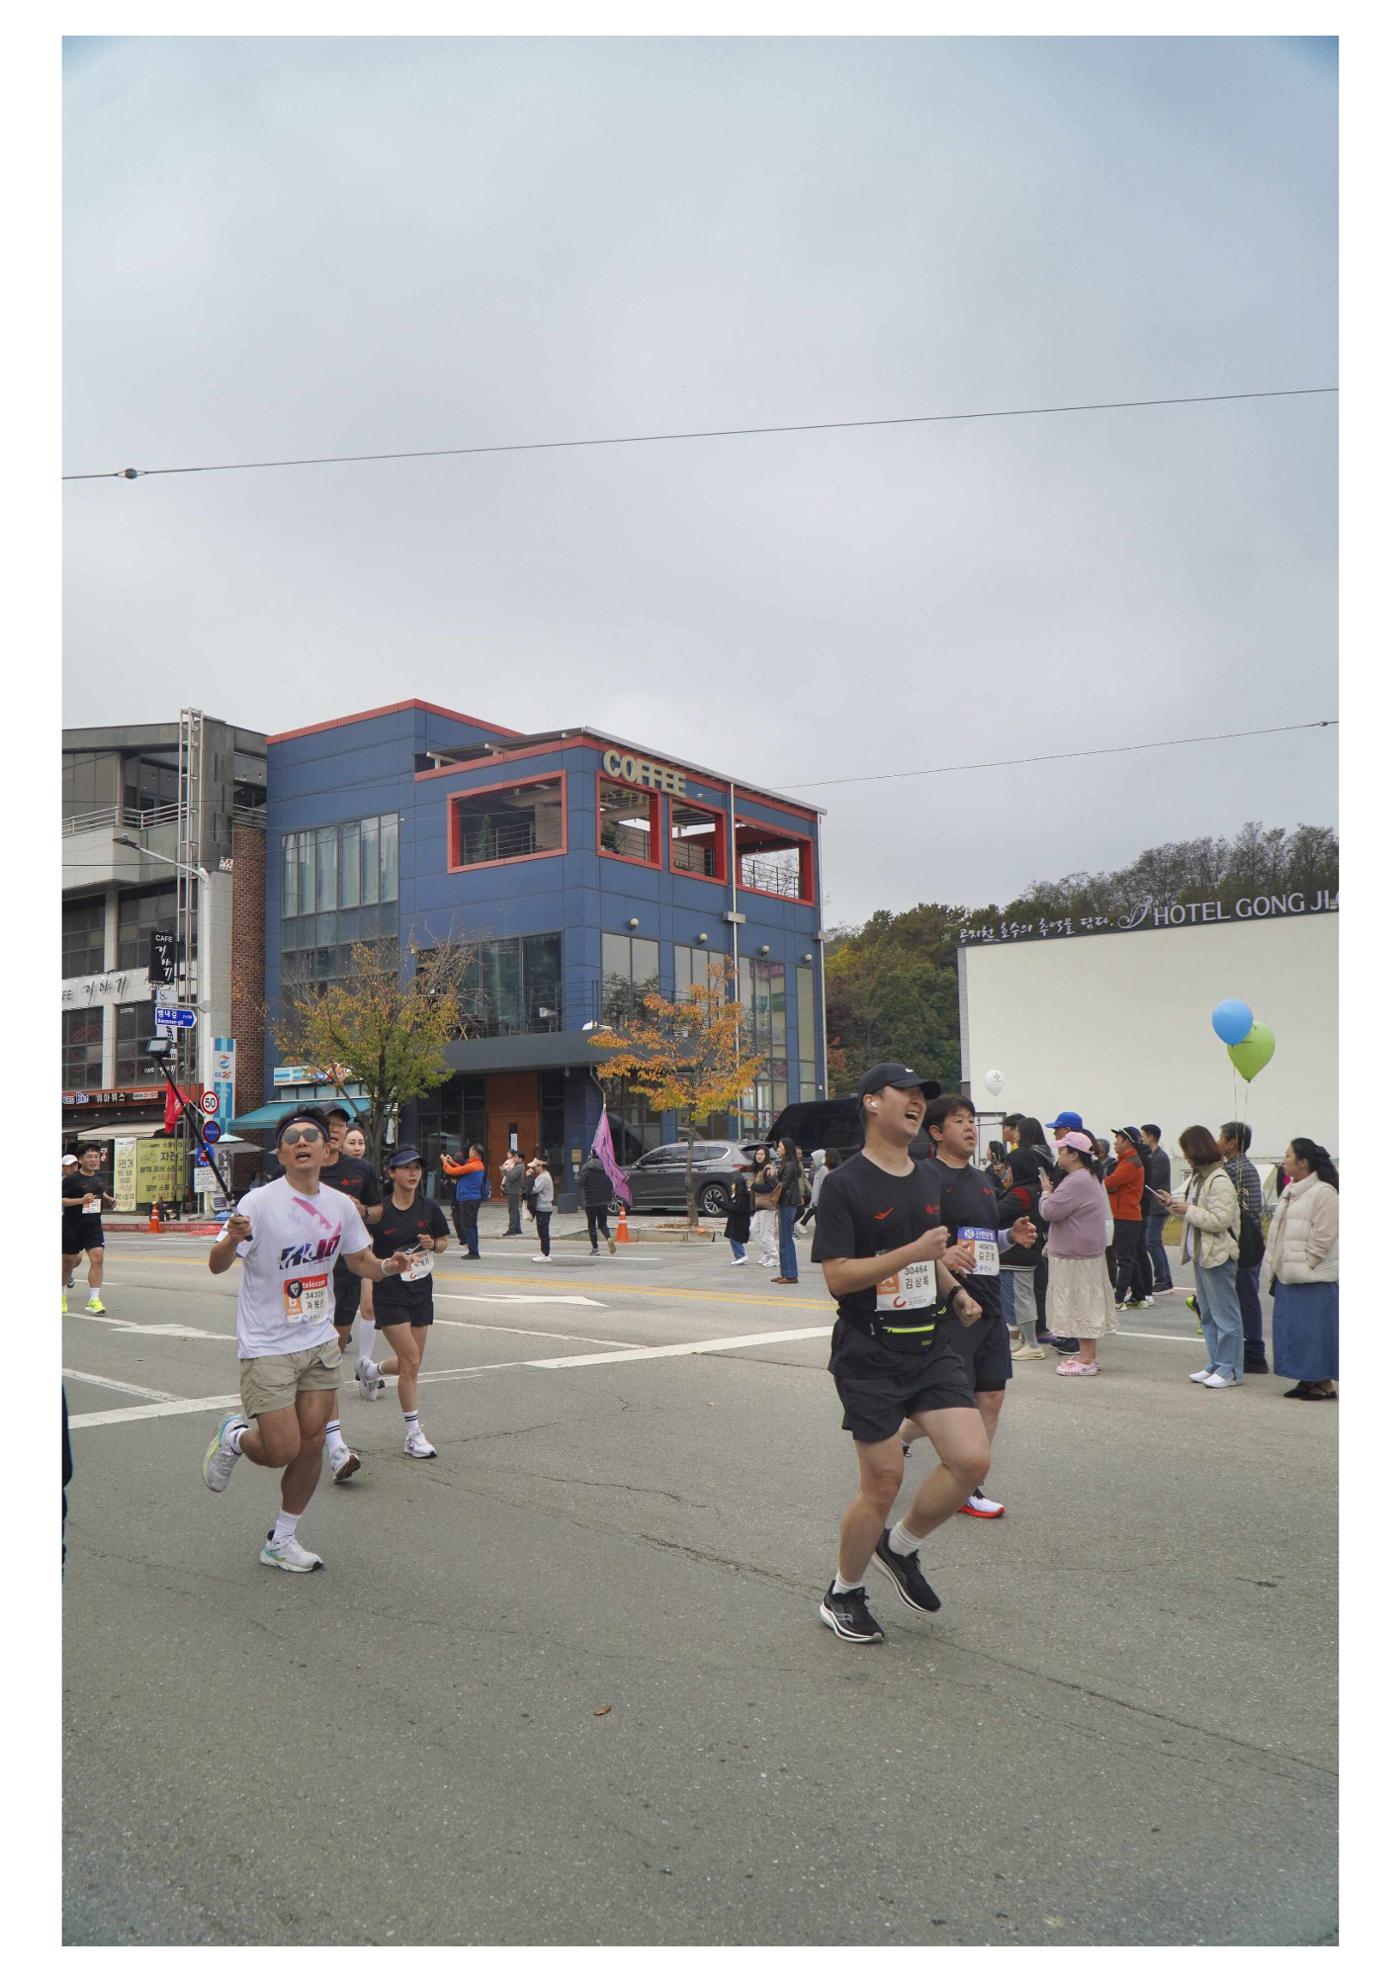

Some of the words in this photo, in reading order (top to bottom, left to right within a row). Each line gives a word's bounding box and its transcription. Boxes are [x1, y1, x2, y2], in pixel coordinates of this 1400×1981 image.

[603, 749, 687, 798] COFFEE
[1154, 901, 1231, 926] HOTEL
[1235, 892, 1306, 918] GONG
[155, 934, 173, 943] CAFE
[959, 926, 995, 944] 공지천
[1001, 921, 1032, 939] 호수의
[1039, 917, 1075, 937] 추억을
[205, 1097, 216, 1108] 50
[904, 1264, 928, 1276] 30464
